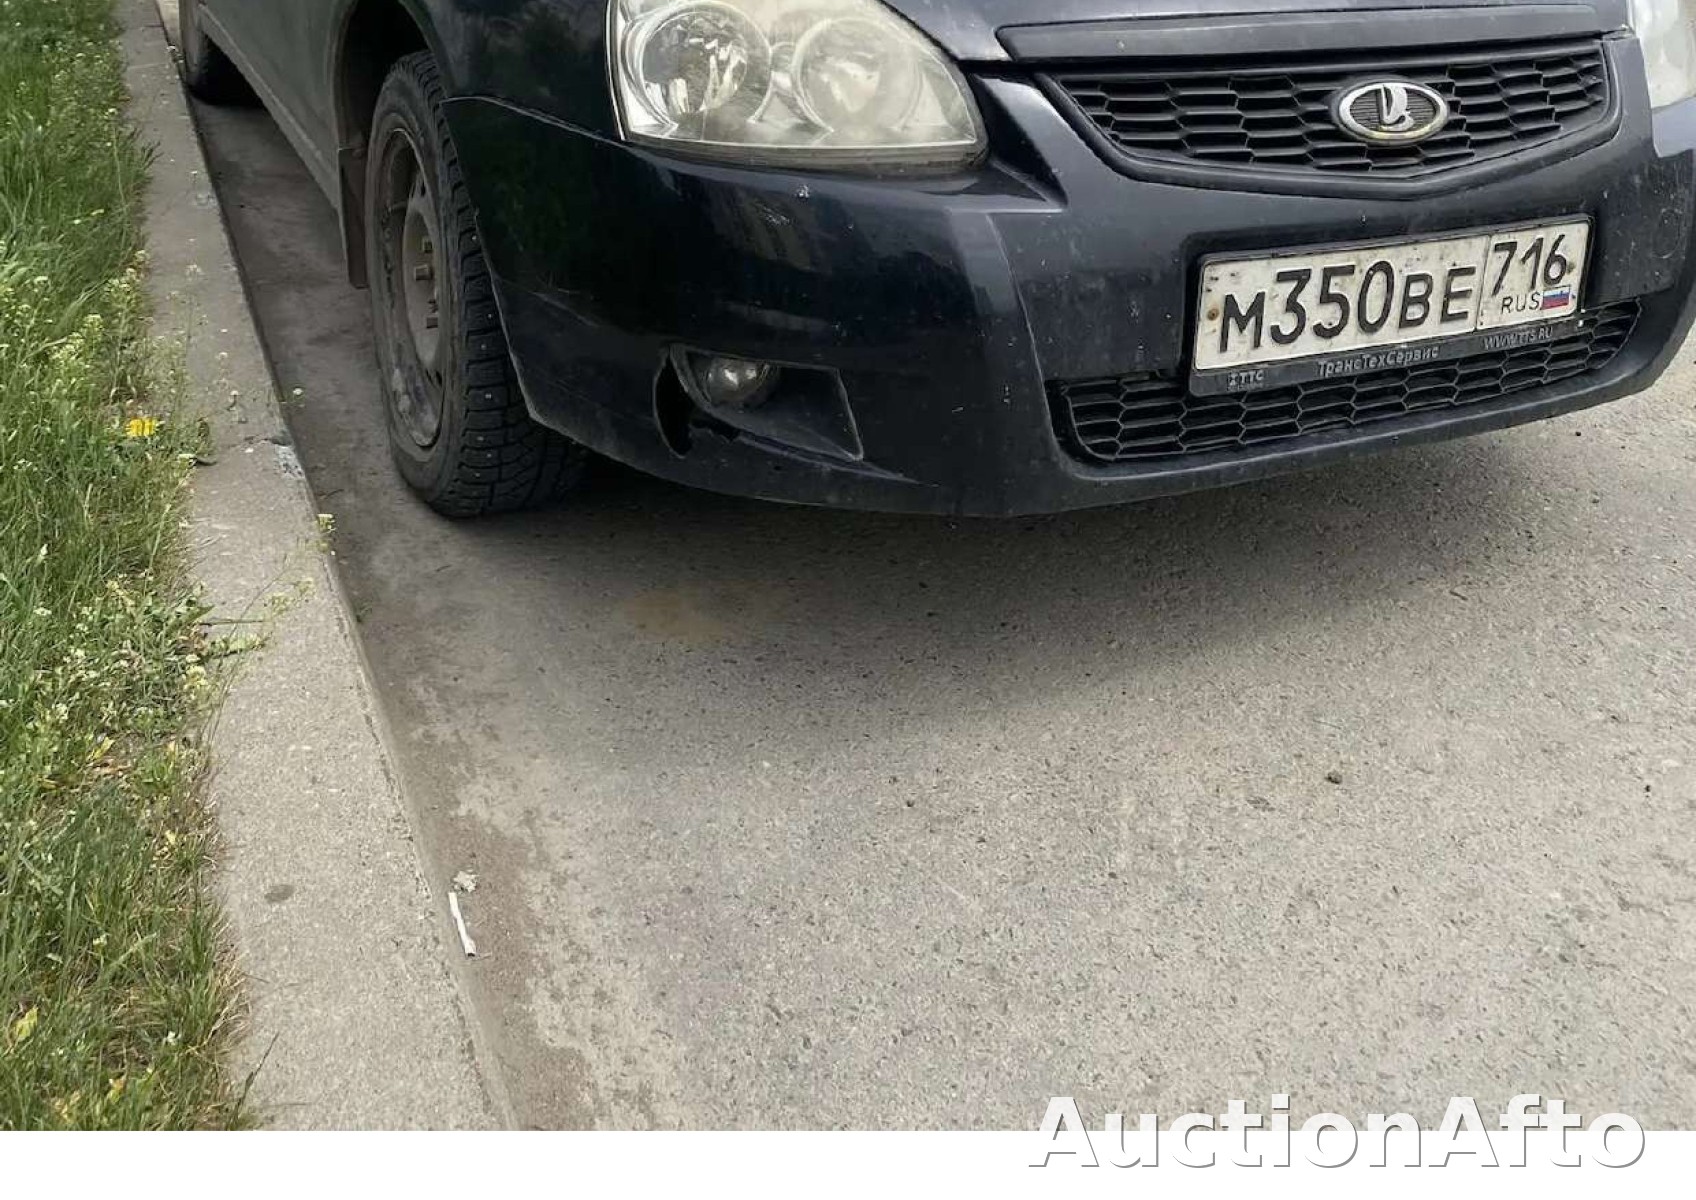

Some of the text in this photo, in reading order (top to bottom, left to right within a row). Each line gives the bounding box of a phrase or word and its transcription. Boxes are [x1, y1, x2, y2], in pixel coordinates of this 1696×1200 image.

[1492, 233, 1567, 297] 716
[1500, 291, 1540, 315] RUS
[1318, 346, 1439, 378] ТрансТехСервис
